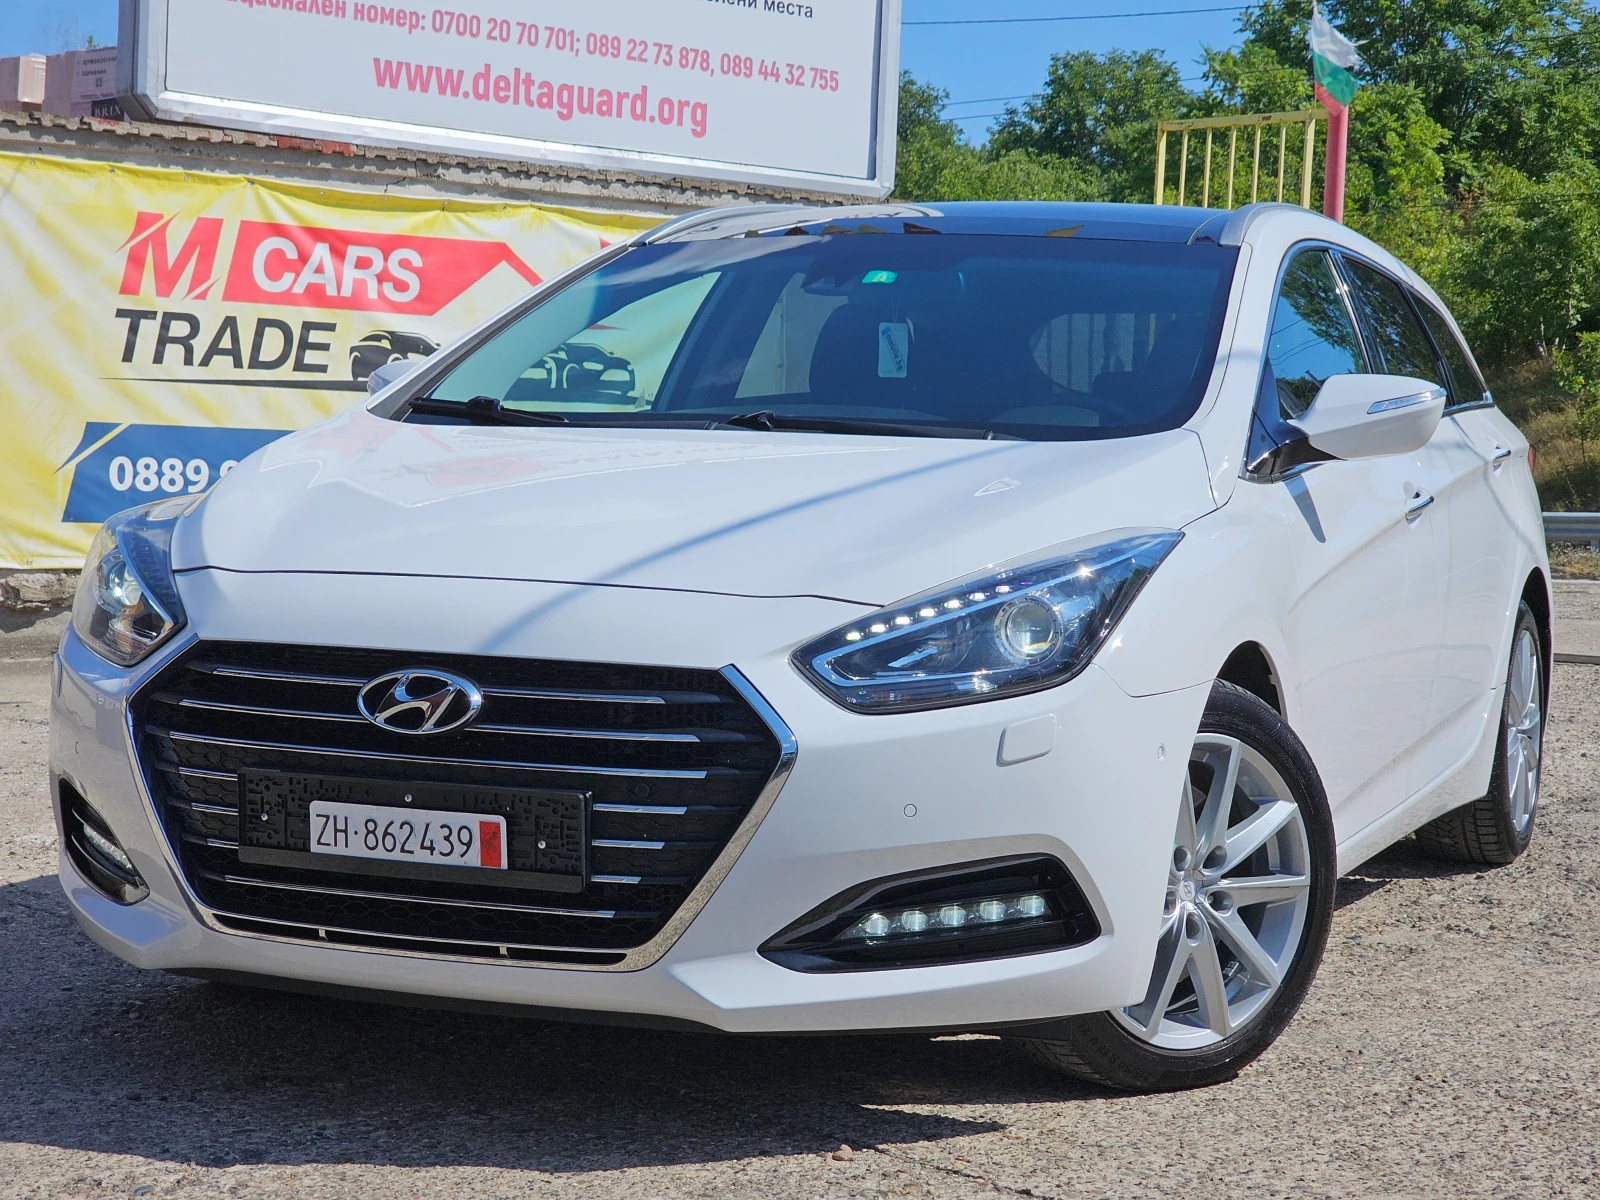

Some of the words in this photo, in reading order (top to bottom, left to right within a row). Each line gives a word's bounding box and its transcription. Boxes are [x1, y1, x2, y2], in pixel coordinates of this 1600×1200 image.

[763, 0, 813, 18] места
[353, 3, 425, 35] номер:
[431, 9, 481, 39] 0700
[486, 17, 511, 43] 20
[515, 21, 539, 47] 70
[544, 25, 581, 58] 701;
[586, 32, 621, 59] 089
[626, 38, 648, 63] 22
[652, 42, 673, 67] 73
[678, 46, 715, 77] 878,
[720, 53, 753, 79] 089
[758, 59, 781, 83] 44
[785, 63, 805, 87] 32
[809, 66, 839, 92] 755
[373, 57, 708, 138] www.deltaguard.org
[252, 236, 424, 303] CARS
[115, 308, 338, 374] TRADE
[109, 455, 210, 493] 0889
